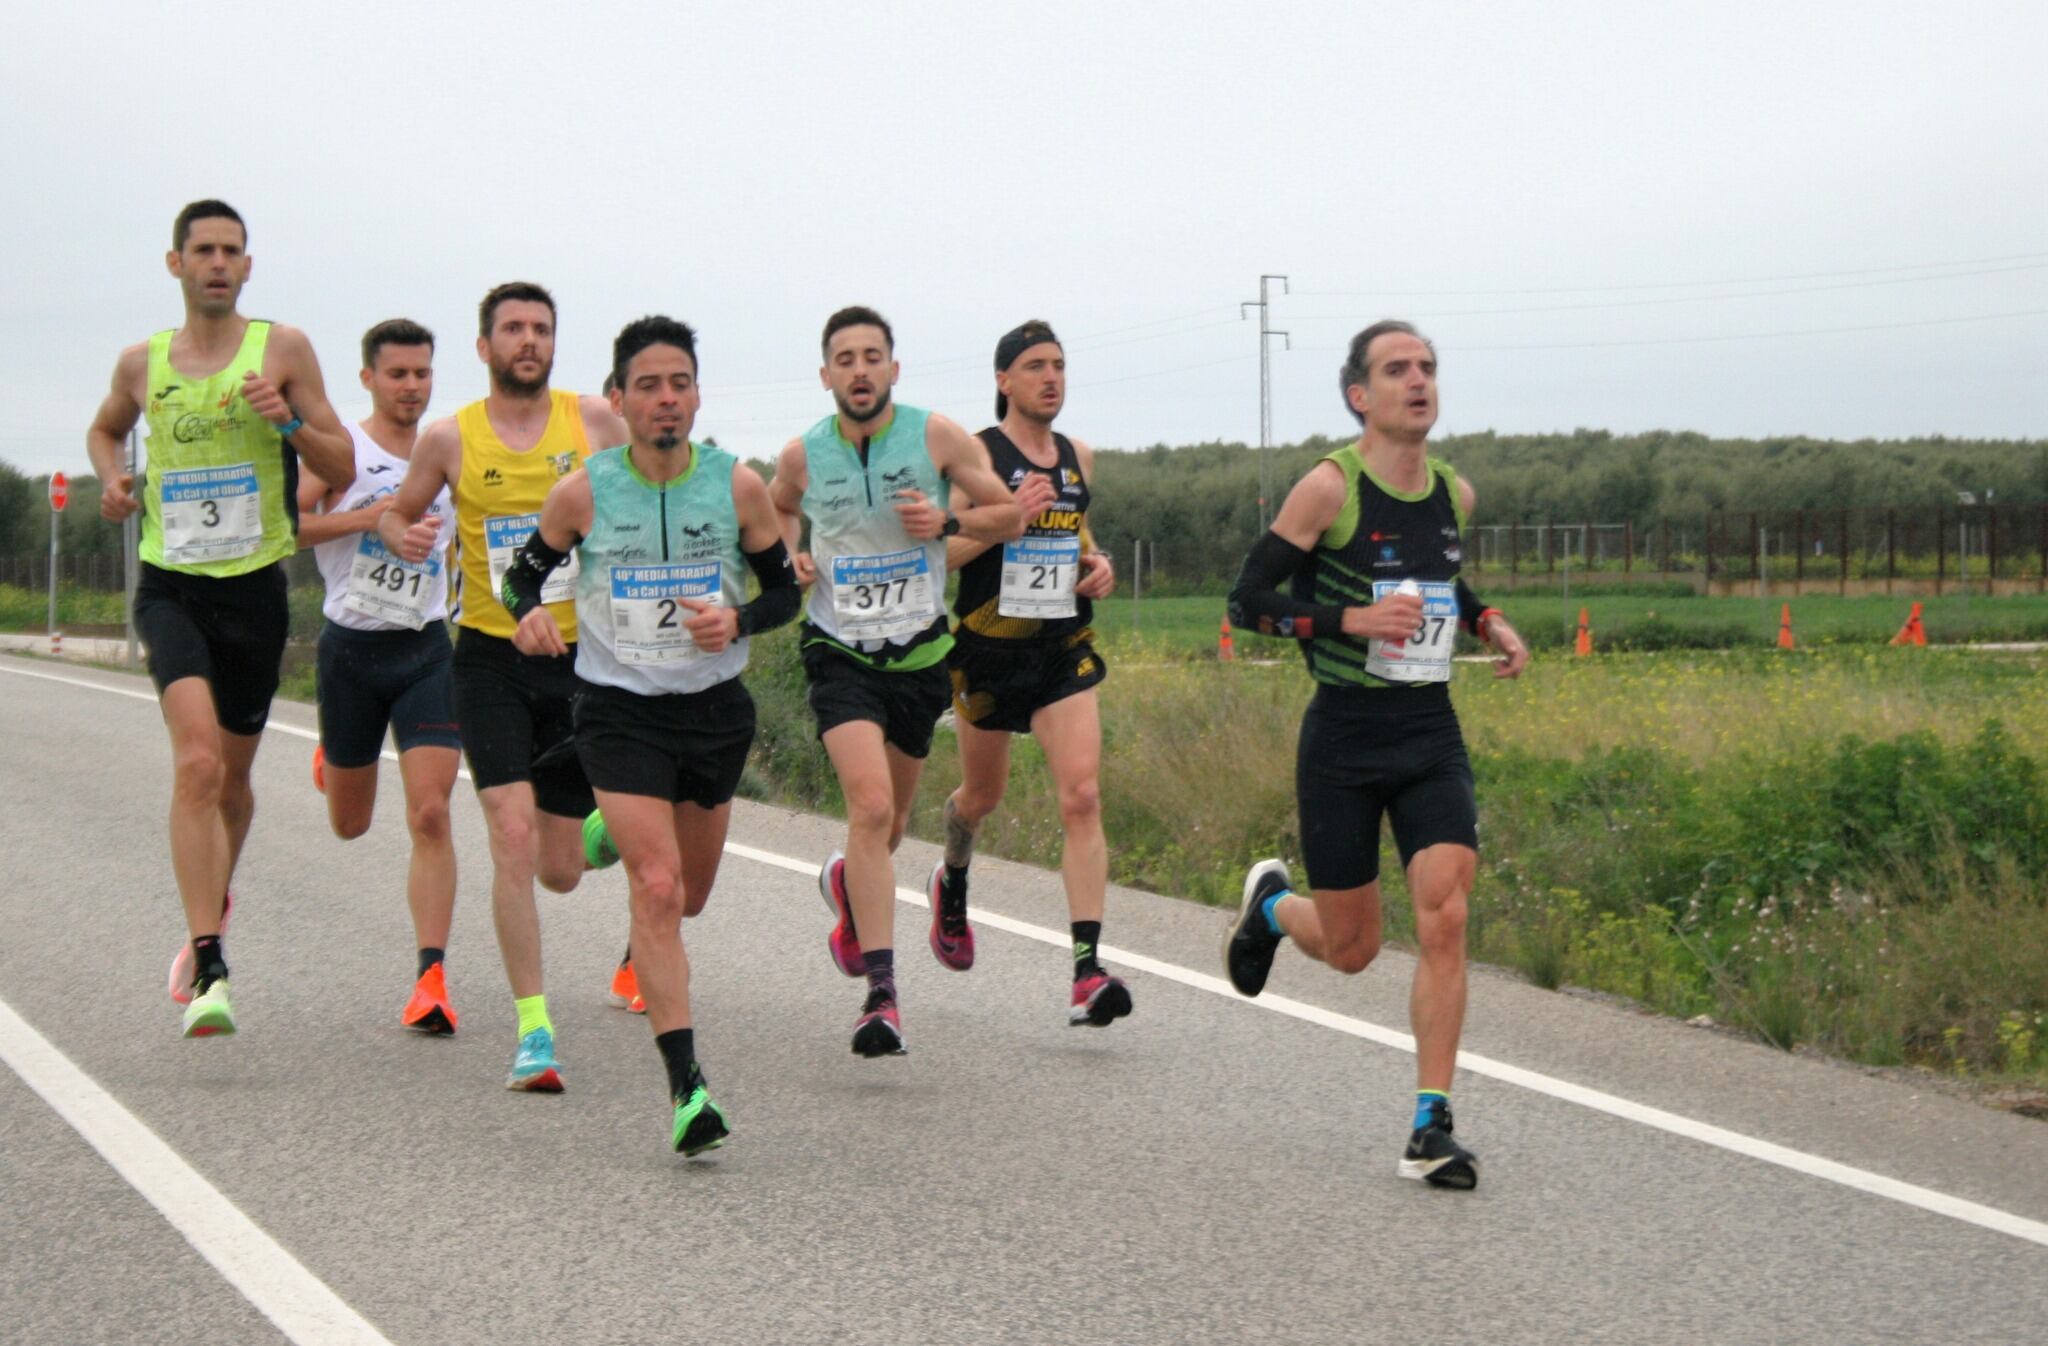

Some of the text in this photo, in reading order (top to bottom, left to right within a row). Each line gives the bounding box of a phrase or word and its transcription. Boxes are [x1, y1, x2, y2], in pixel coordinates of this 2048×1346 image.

[183, 487, 200, 499] Cal
[200, 500, 220, 528] 3
[368, 563, 422, 598] 491
[635, 569, 668, 582] MEDIA
[1029, 565, 1058, 589] 21
[640, 585, 659, 597] Cal
[660, 586, 667, 597] y
[669, 584, 679, 595] el
[855, 578, 908, 609] 377
[657, 599, 677, 629] 2
